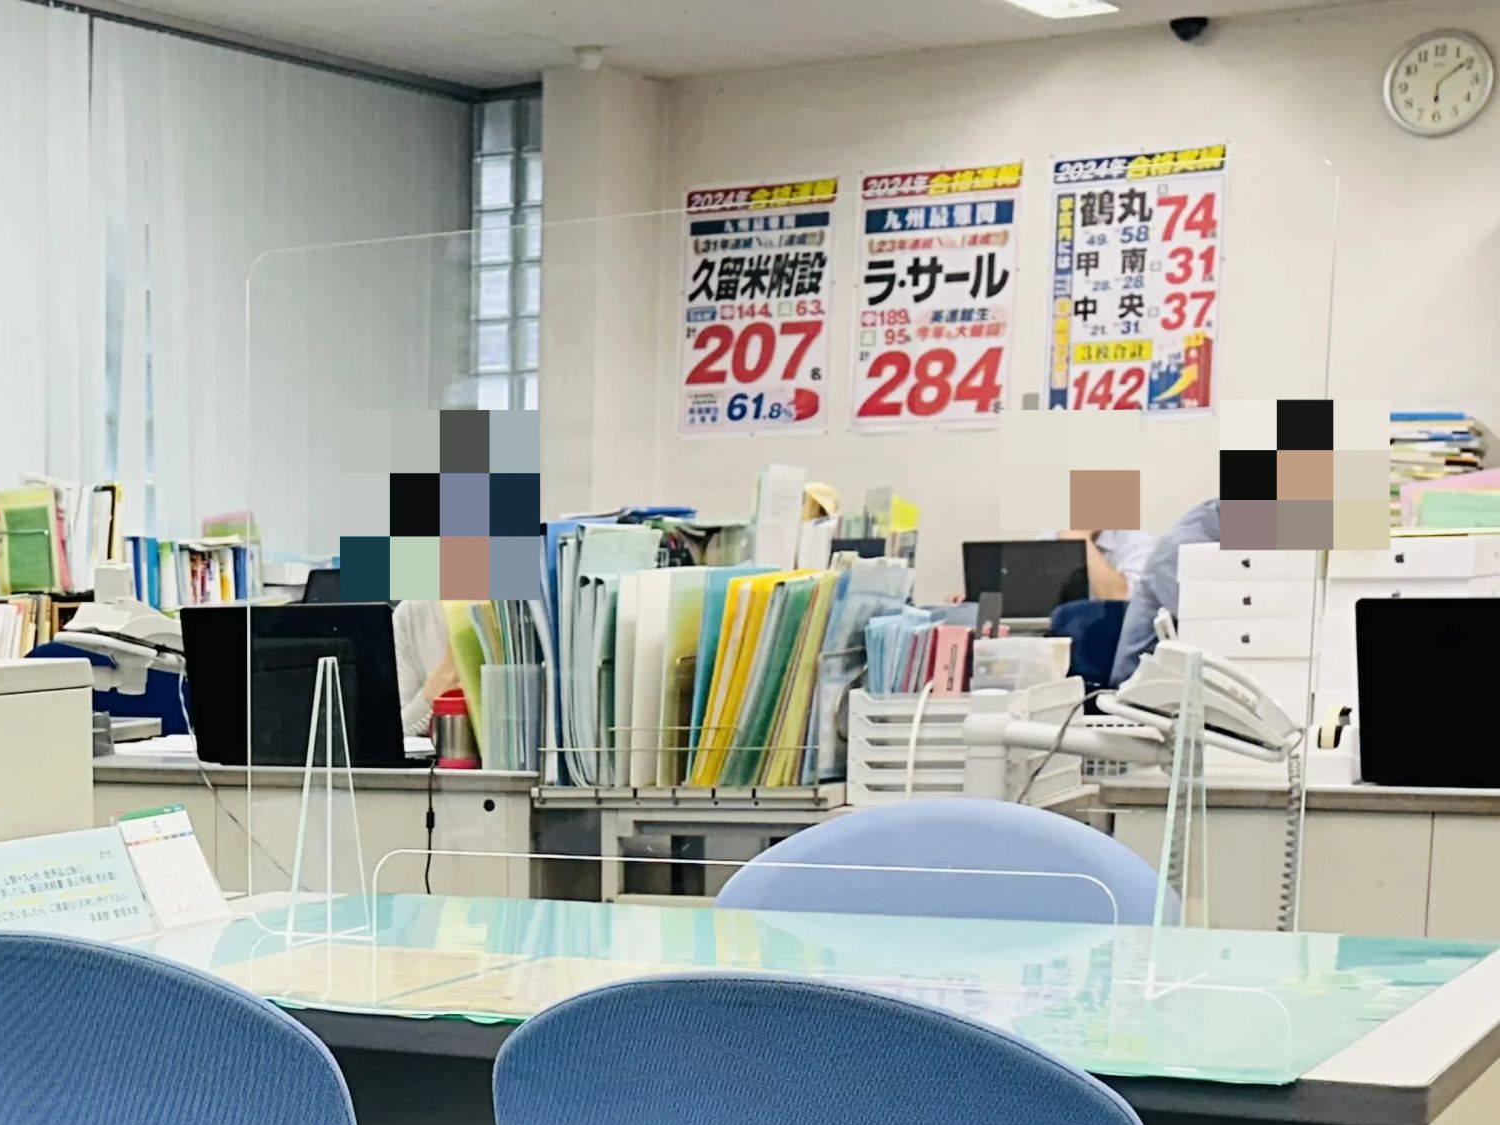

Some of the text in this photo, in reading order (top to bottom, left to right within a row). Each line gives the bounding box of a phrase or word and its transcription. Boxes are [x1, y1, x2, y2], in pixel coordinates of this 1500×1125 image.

[1081, 188, 1152, 227] 鶴丸
[1156, 193, 1217, 242] 74
[1120, 226, 1150, 244] 58
[688, 252, 827, 301] 久留米附設
[864, 253, 1010, 306] ラ・サール
[1122, 275, 1144, 289] 28
[1165, 246, 1216, 285] 31
[1120, 321, 1140, 334] 31
[1160, 291, 1216, 331] 37
[685, 321, 823, 385] 207
[856, 346, 1004, 417] 284
[1072, 367, 1145, 410] 142
